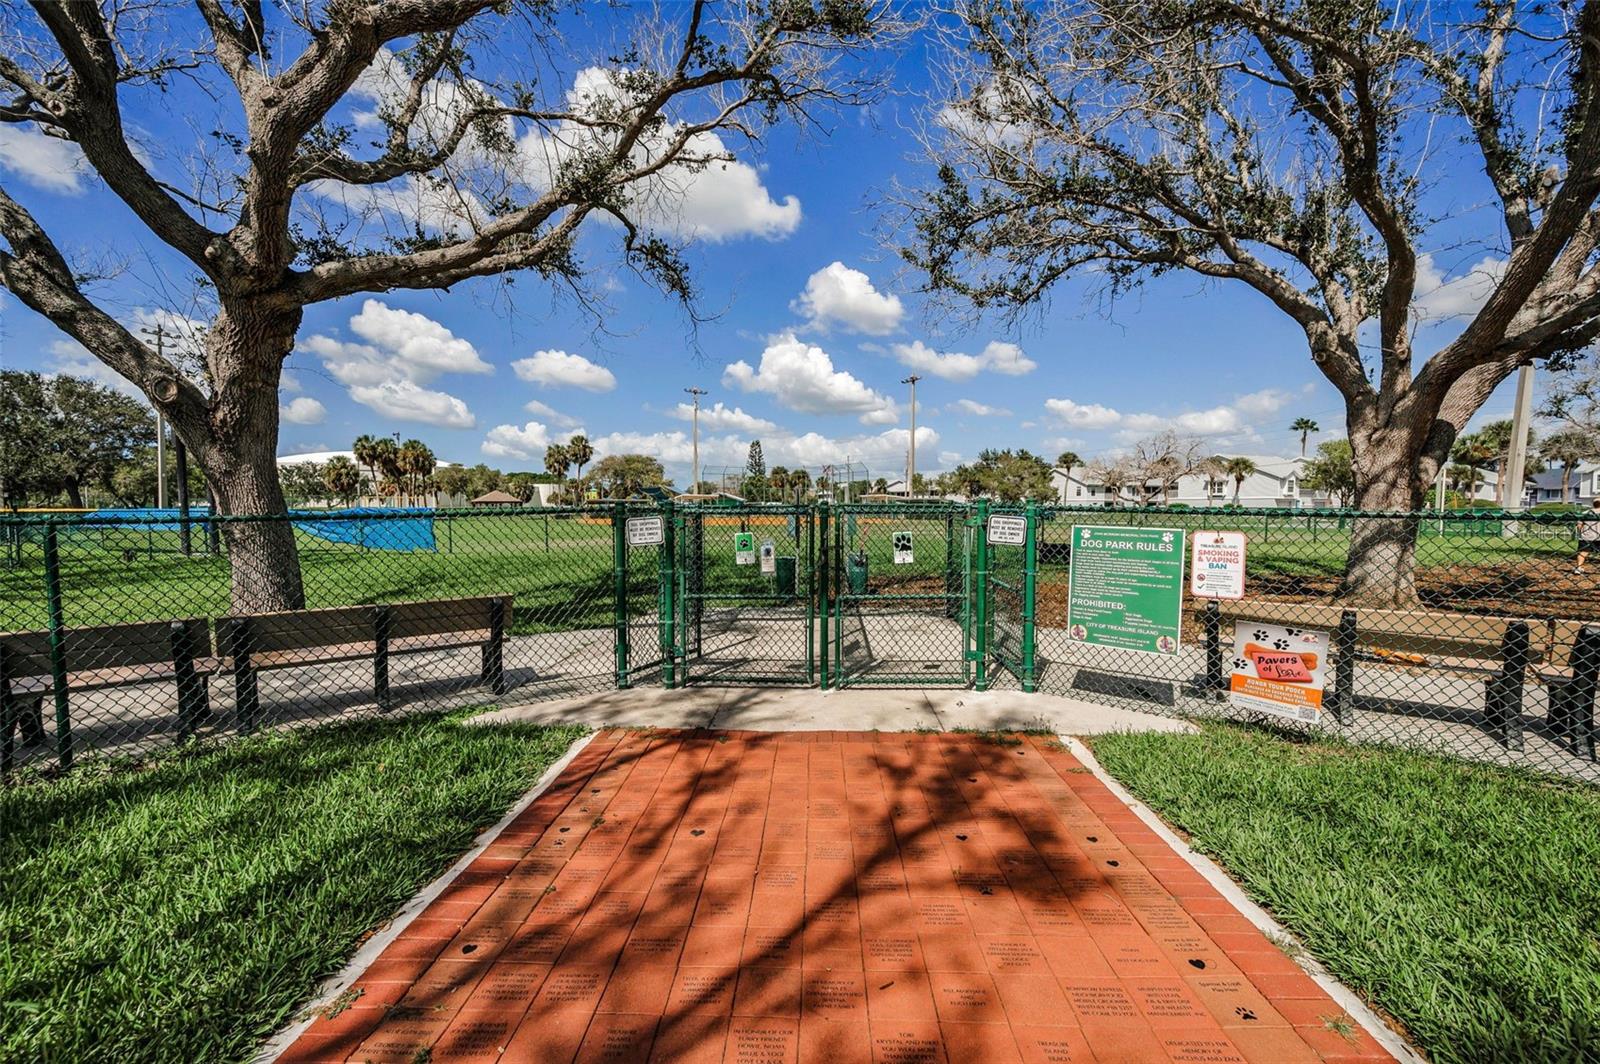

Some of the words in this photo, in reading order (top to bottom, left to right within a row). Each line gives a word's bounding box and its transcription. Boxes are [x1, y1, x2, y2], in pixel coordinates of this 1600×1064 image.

[1105, 541, 1133, 550] PARK
[1137, 543, 1173, 552] RULES
[1072, 598, 1126, 610] PROHIBITED:
[1108, 624, 1136, 633] TREASURE
[1137, 628, 1159, 636] ISLAND
[1257, 656, 1298, 665] Pavers
